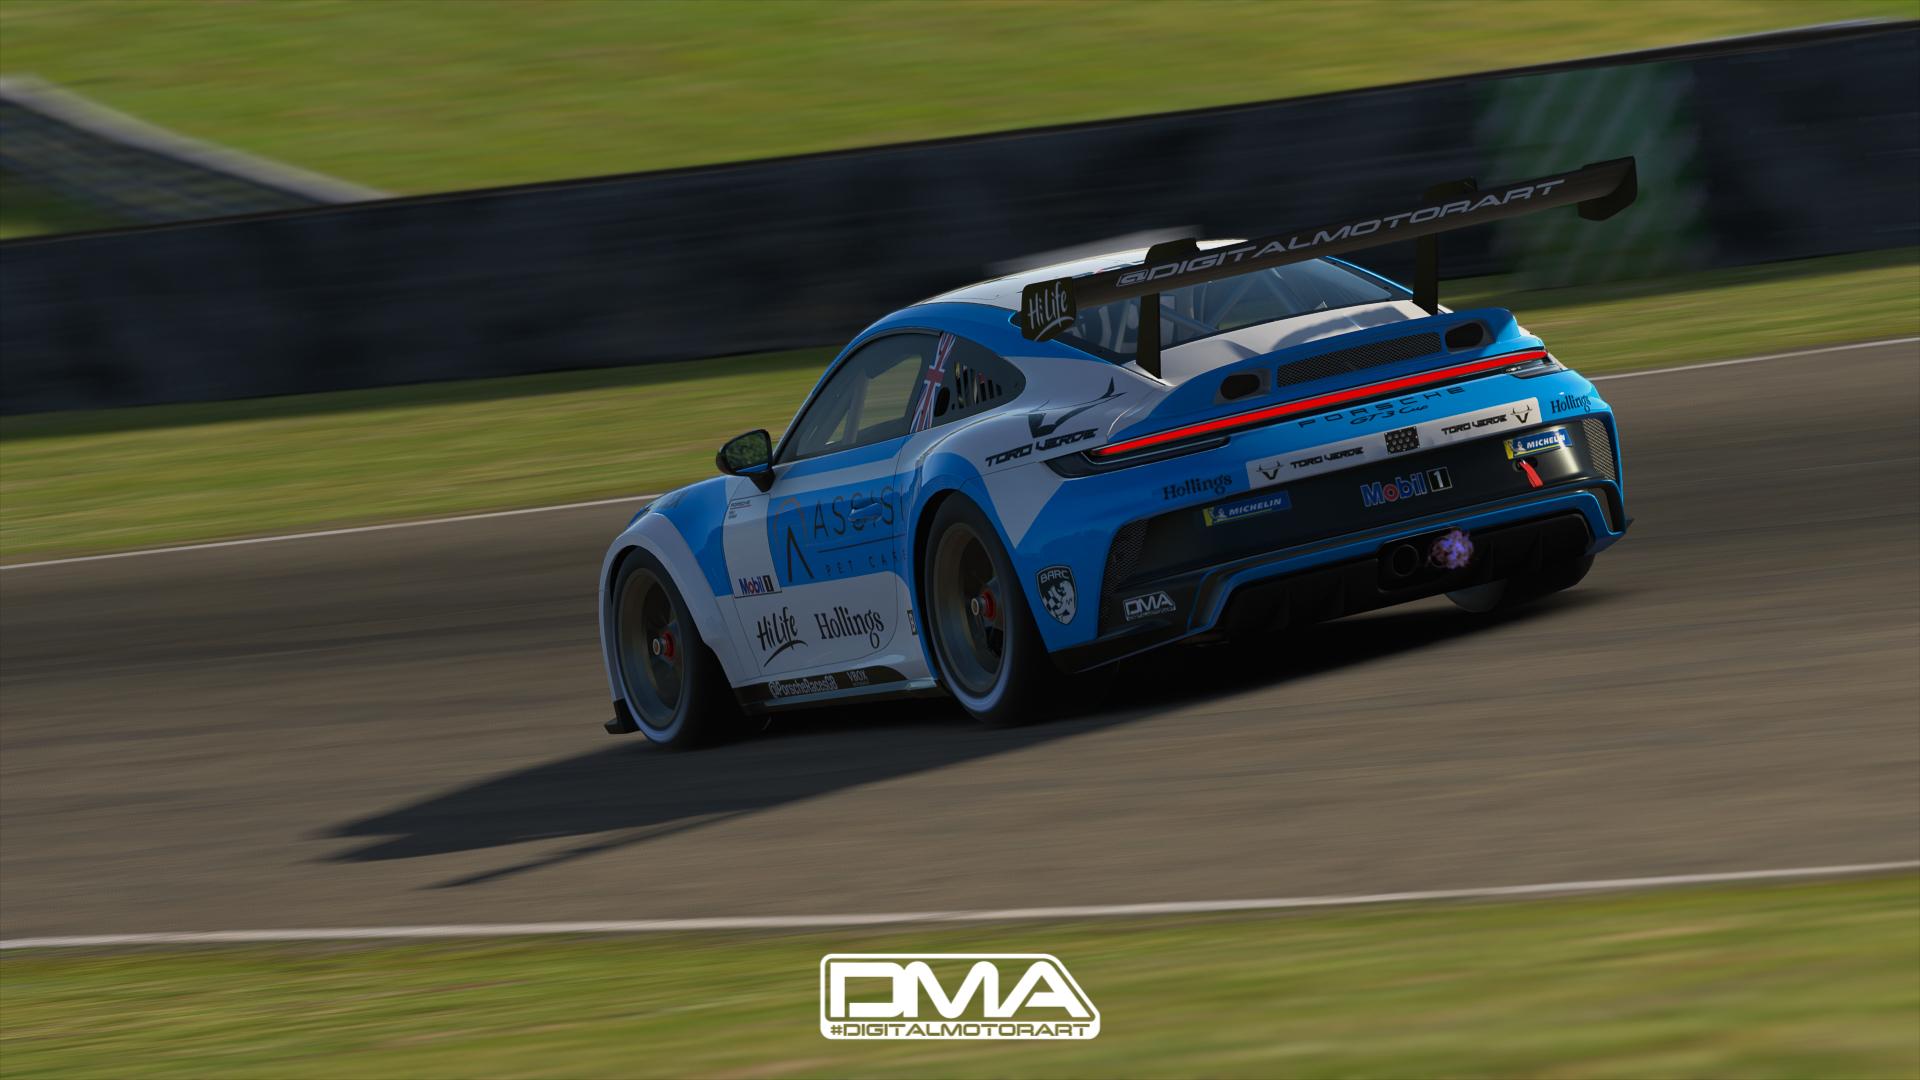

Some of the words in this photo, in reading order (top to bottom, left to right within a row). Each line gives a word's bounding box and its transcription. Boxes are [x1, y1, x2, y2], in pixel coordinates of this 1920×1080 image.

[1116, 178, 1566, 288] @DIGITALMOTORART
[1028, 281, 1068, 330] HiLife
[1297, 386, 1466, 429] PORSCHE
[1350, 410, 1394, 426] GT3
[1399, 404, 1429, 416] Cup
[1551, 394, 1592, 414] Hollings
[1440, 422, 1472, 436] TORO
[1526, 432, 1567, 450] MICHELIN
[984, 443, 1034, 468] TORO
[1289, 456, 1324, 470] TORO
[1162, 472, 1233, 500] Hollings
[1360, 472, 1428, 508] Mobil
[1228, 497, 1283, 517] MICHELIN
[825, 559, 855, 577] PET
[1040, 568, 1070, 584] BARC
[738, 575, 764, 595] Mobil
[1125, 592, 1174, 617] DMA
[757, 606, 799, 652] HiLife
[813, 605, 885, 649] Hollings
